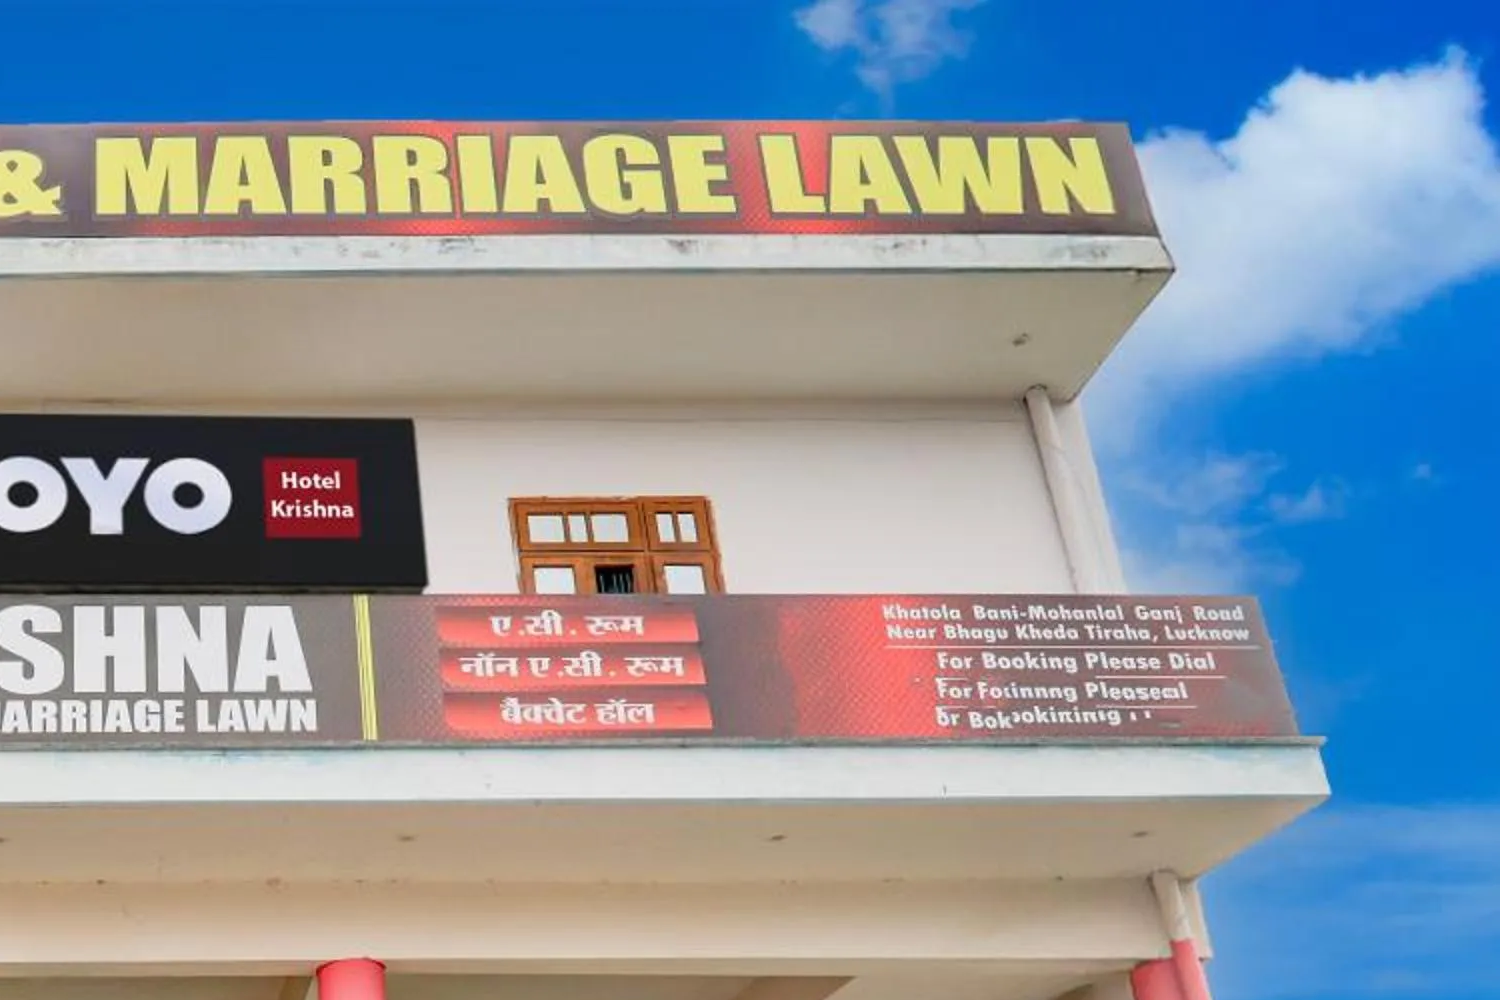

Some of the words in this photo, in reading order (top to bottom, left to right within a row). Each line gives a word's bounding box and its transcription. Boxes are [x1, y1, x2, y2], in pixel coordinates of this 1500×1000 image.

[94, 134, 738, 218] MARRIAGE
[758, 134, 1116, 216] LAWN
[281, 470, 341, 489] Hotel
[270, 499, 355, 518] Krishna
[882, 604, 961, 621] Khatola
[972, 604, 1125, 622] Bani-Mohanlal
[1134, 604, 1183, 625] Ganj
[1192, 605, 1245, 621] Road
[584, 615, 645, 636] रूम
[886, 624, 937, 640] Near
[944, 624, 1009, 643] Bhagu
[1084, 623, 1158, 643] Tiraha,
[1164, 625, 1250, 641] Lucknow
[459, 653, 519, 678] नॉन
[624, 656, 685, 678] रूम
[936, 652, 973, 670] For
[980, 652, 1078, 674] Booking
[1084, 652, 1161, 670] Please
[1168, 652, 1217, 670] Dial
[935, 679, 973, 699] For
[196, 698, 318, 732] LAWN
[594, 699, 656, 724] हॉल
